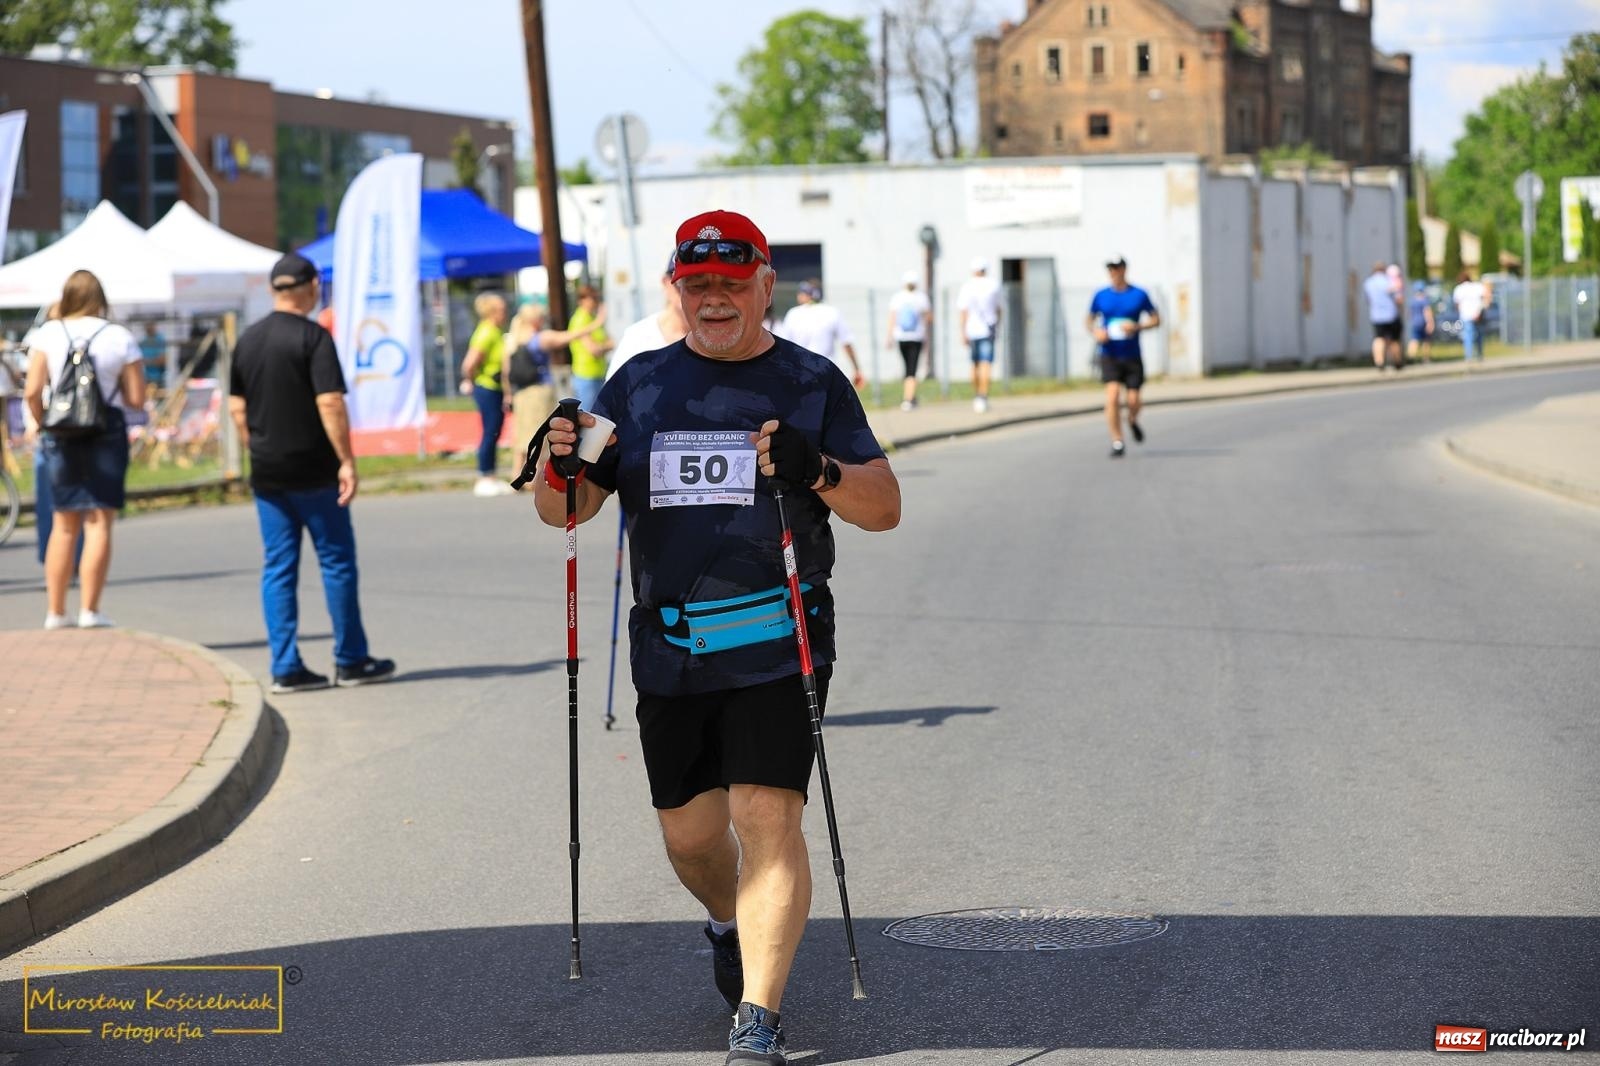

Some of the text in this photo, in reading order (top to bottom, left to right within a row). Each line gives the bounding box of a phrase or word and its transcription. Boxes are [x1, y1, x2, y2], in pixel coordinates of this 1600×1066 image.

[678, 433, 697, 441] BIEG
[680, 455, 729, 484] 50
[785, 553, 793, 570] 300
[794, 607, 804, 645] Quechua
